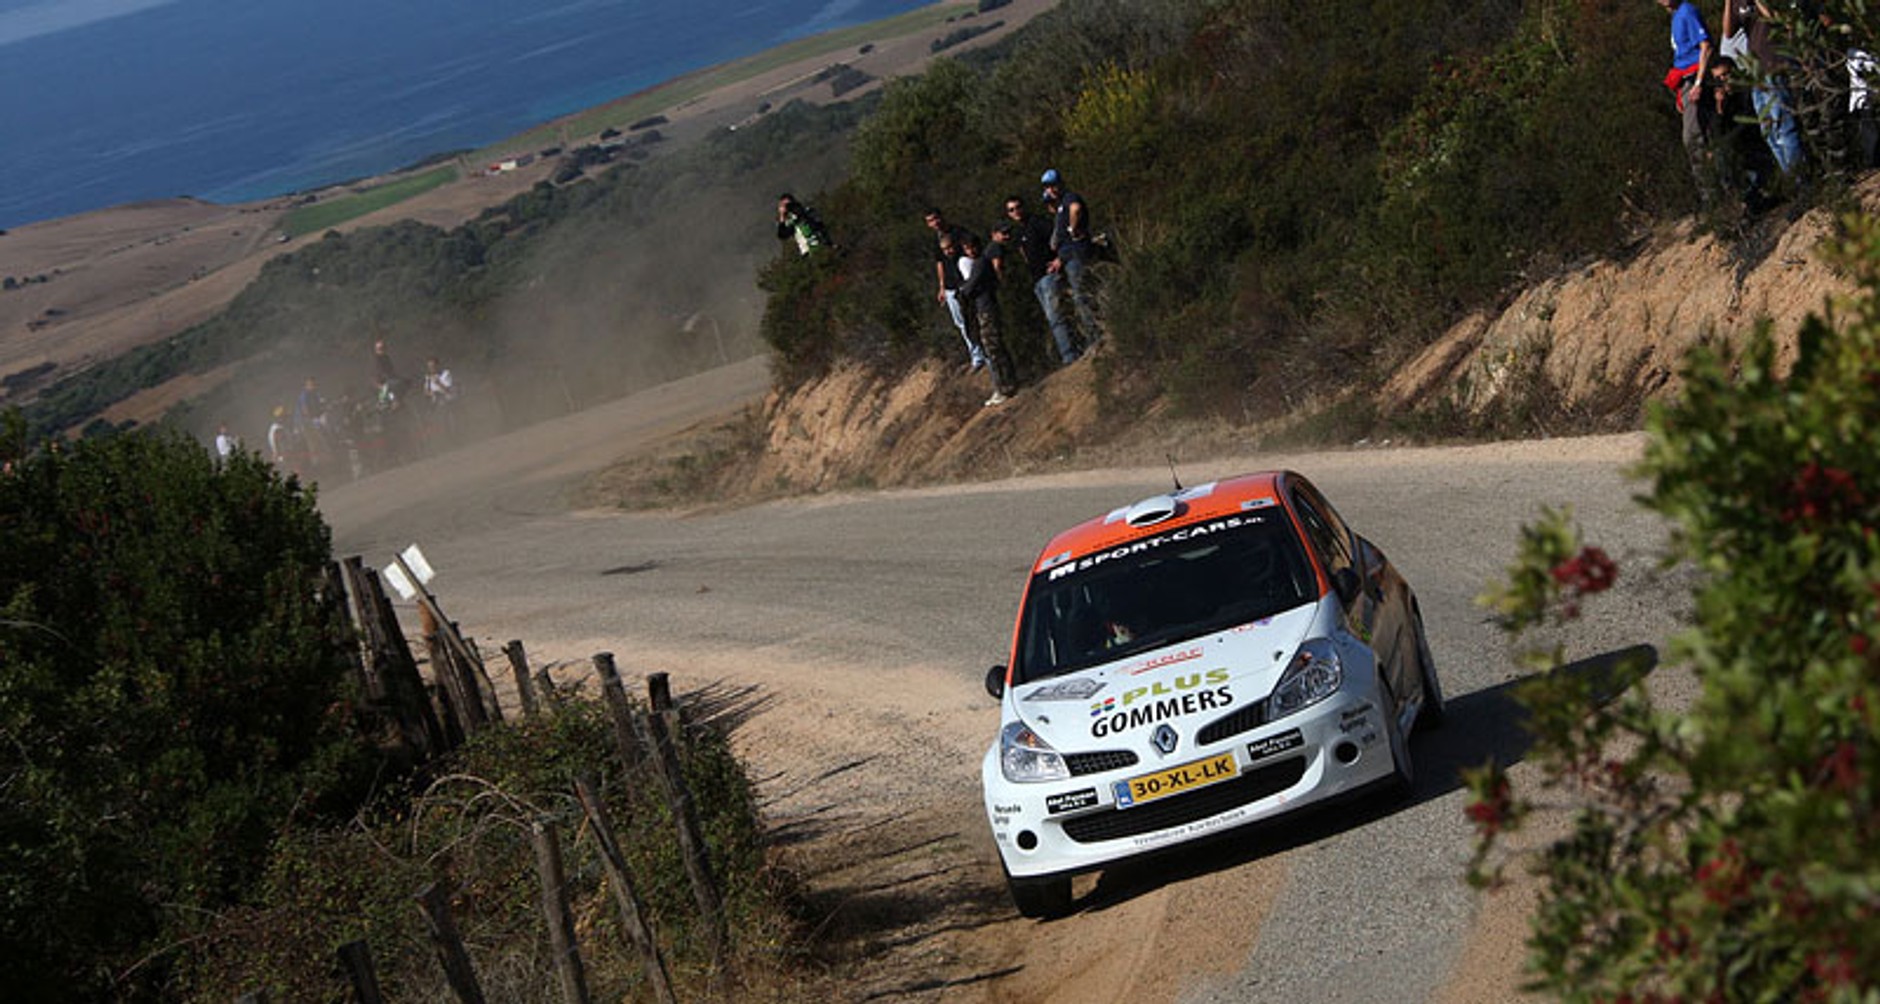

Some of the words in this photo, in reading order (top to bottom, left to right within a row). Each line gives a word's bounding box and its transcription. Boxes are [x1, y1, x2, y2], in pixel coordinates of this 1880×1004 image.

[1122, 668, 1230, 705] PLUS
[1091, 686, 1234, 738] GOMMERS
[1134, 759, 1231, 797] 30-XL-LK
